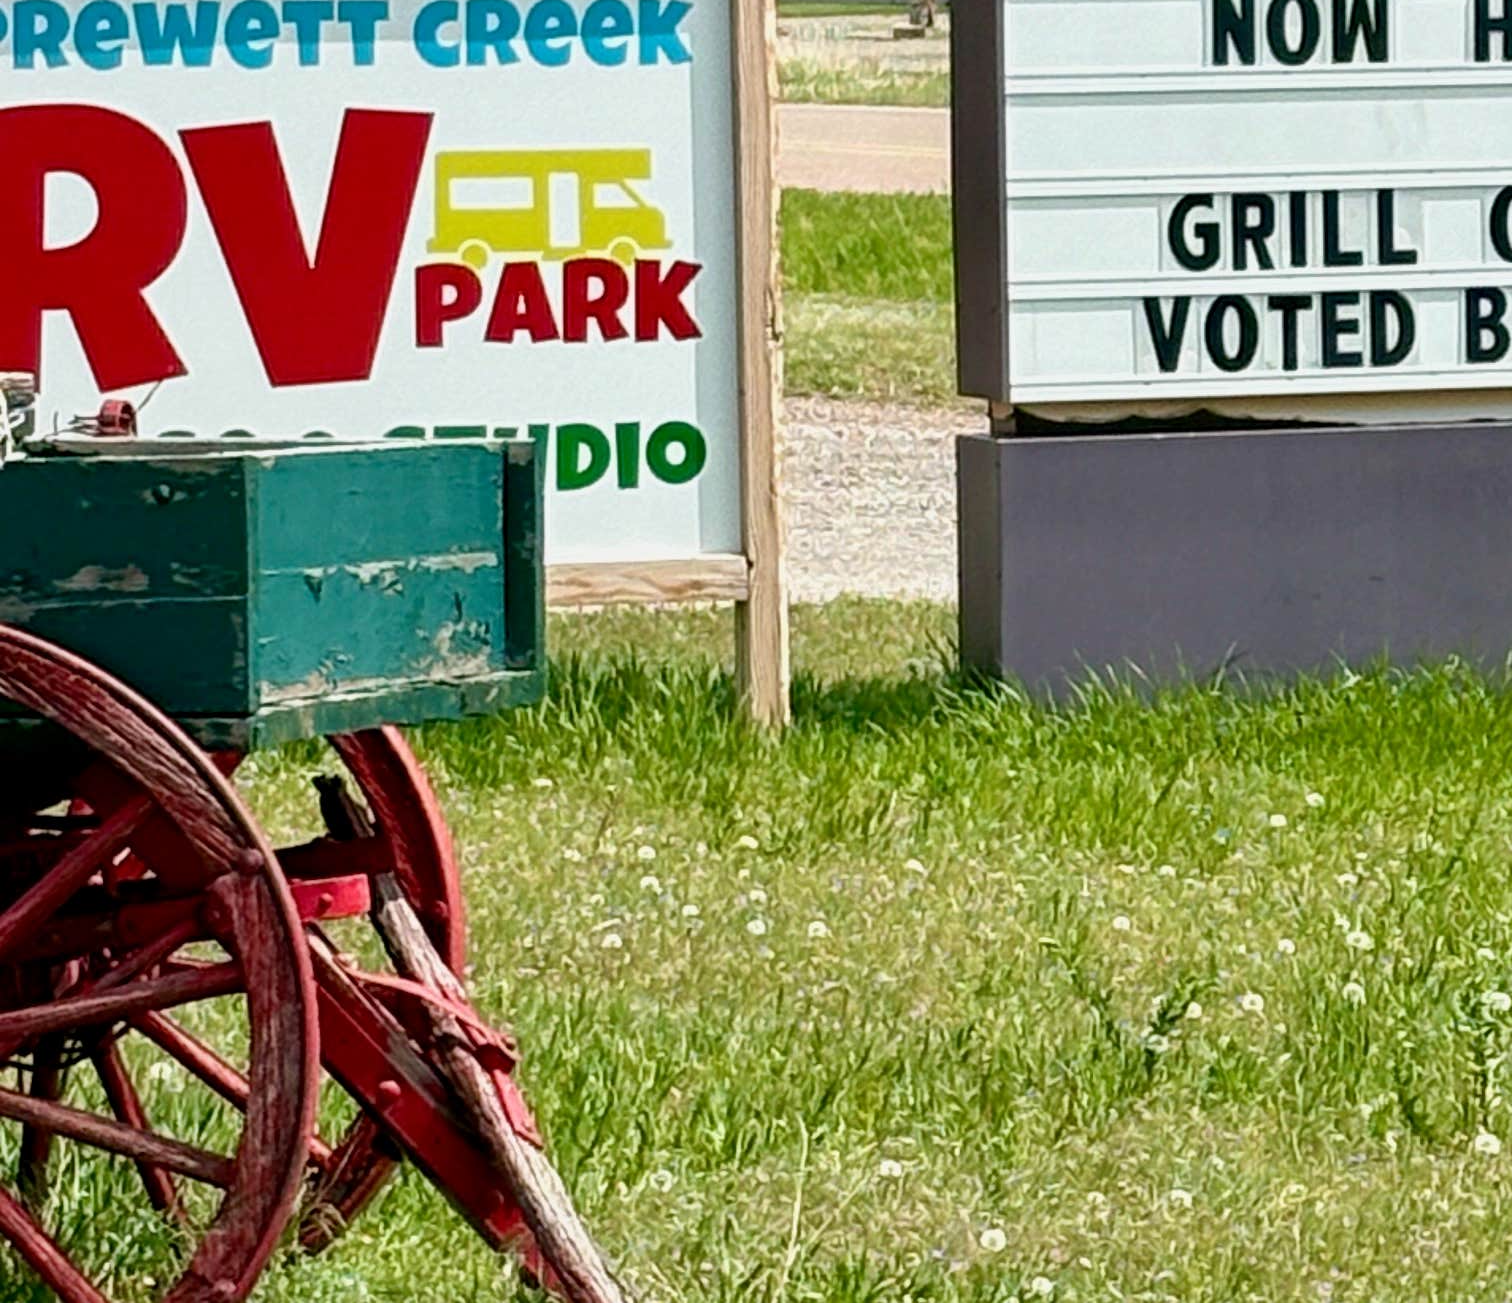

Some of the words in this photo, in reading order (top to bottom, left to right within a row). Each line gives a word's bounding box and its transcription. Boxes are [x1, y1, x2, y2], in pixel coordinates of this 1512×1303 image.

[0, 103, 435, 393] RV
[1166, 186, 1419, 273] GRILL
[415, 257, 702, 348] PARK
[1138, 288, 1416, 374] VOTED
